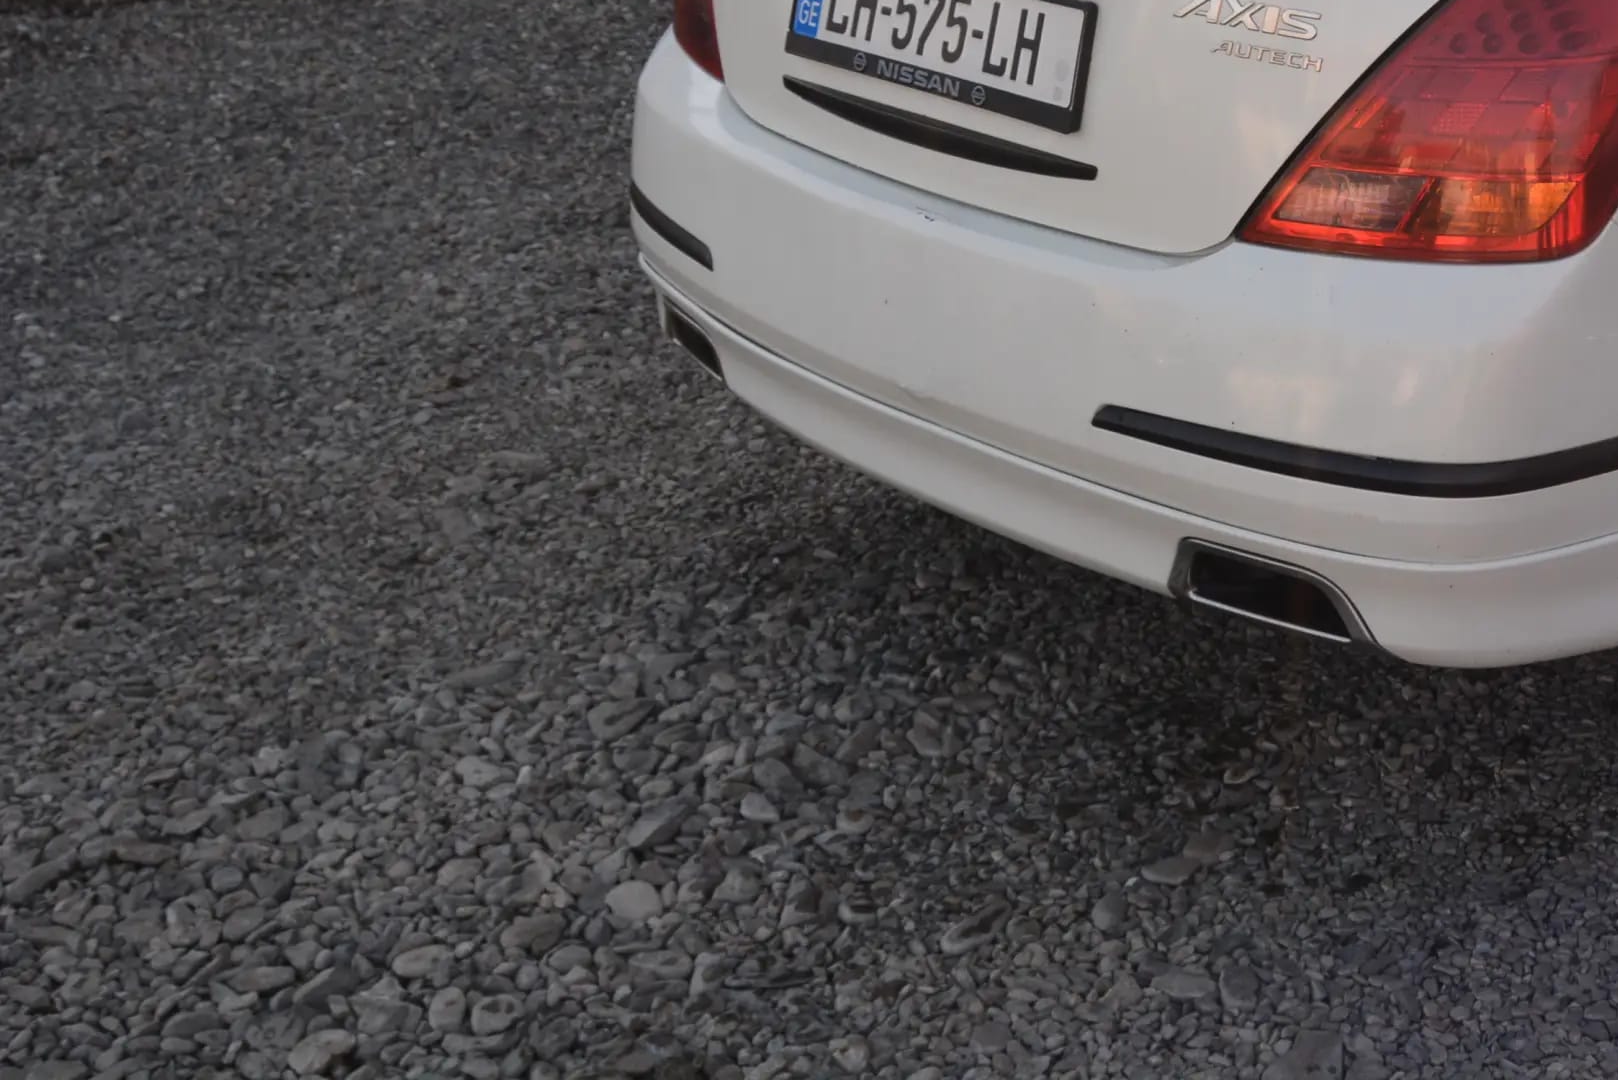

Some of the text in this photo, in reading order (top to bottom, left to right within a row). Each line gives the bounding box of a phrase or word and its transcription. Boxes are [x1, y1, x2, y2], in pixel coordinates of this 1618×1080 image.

[799, 0, 821, 27] GE
[1210, 39, 1324, 72] AUTECH
[875, 59, 961, 98] NISSAN
